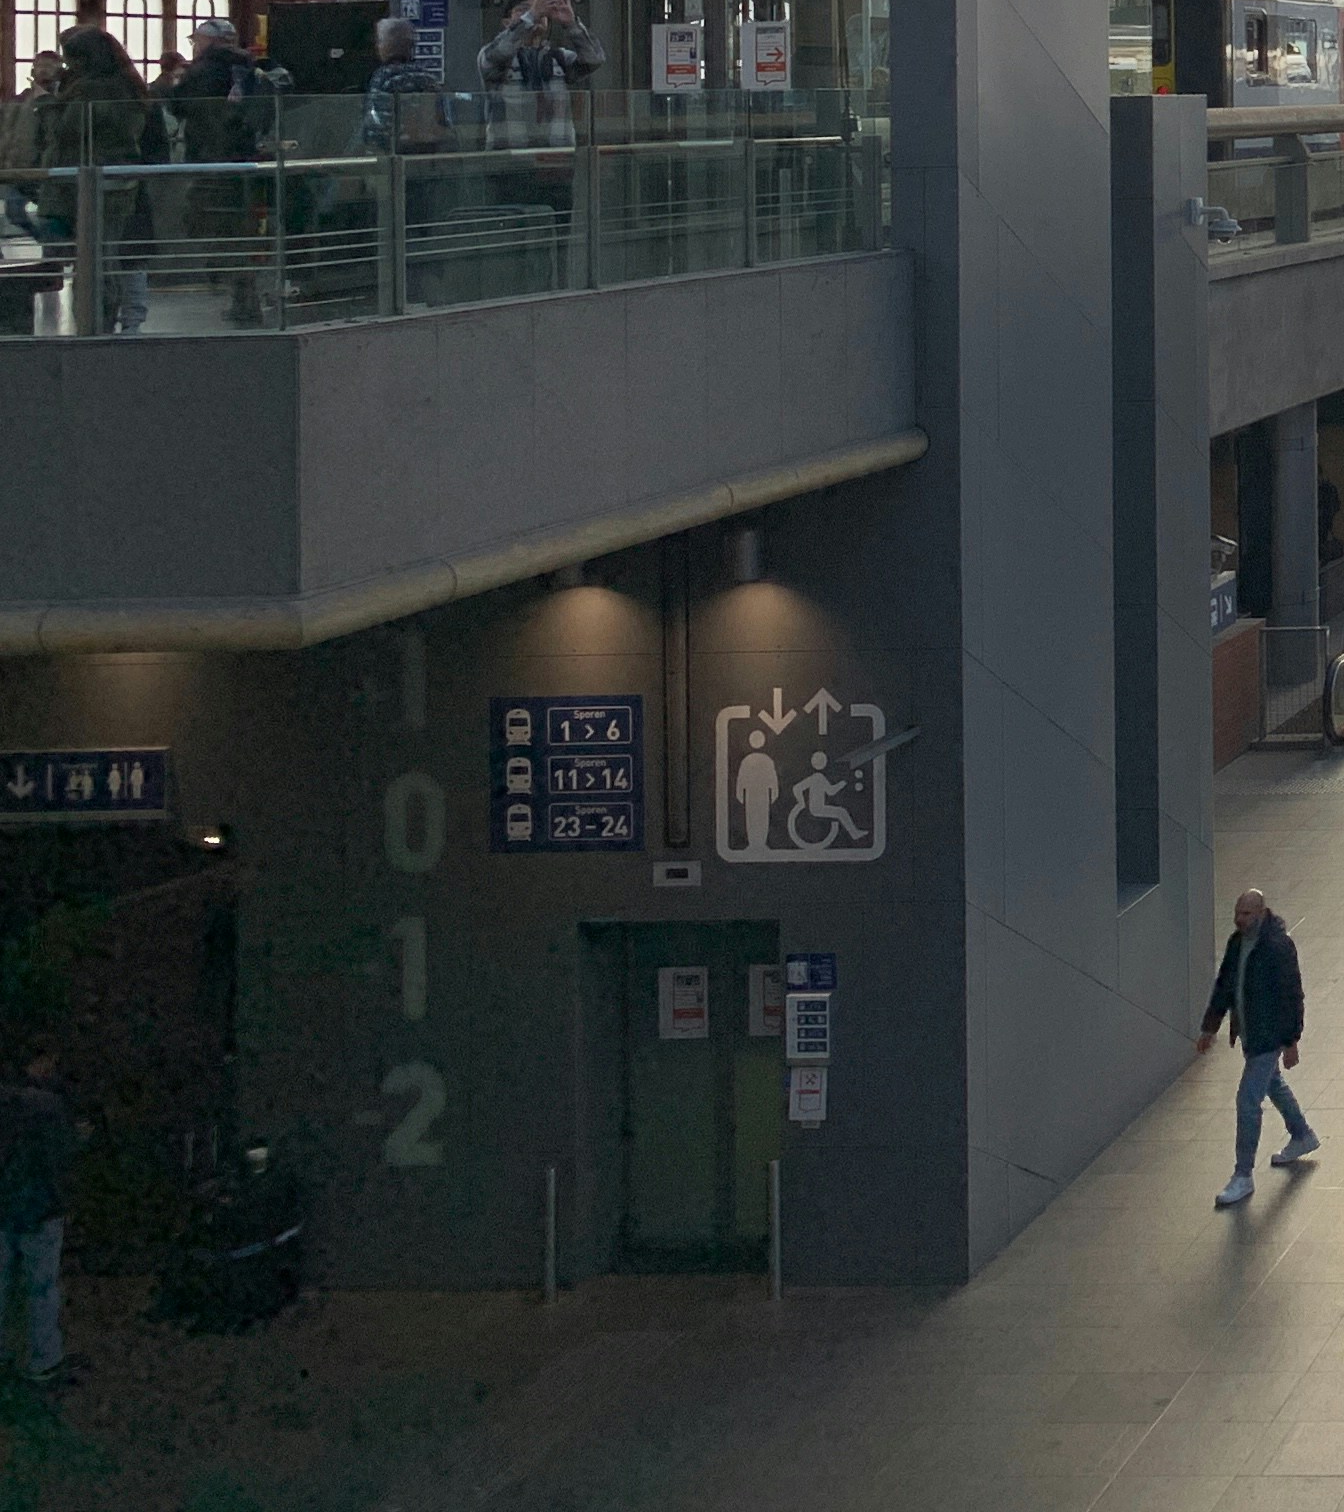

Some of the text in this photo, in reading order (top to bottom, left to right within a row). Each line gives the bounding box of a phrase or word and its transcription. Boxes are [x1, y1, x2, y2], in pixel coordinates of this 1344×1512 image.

[573, 710, 606, 720] Sporen
[560, 720, 570, 741] 1
[606, 719, 620, 741] 6
[574, 758, 607, 768] Sporen
[382, 770, 446, 873] 0
